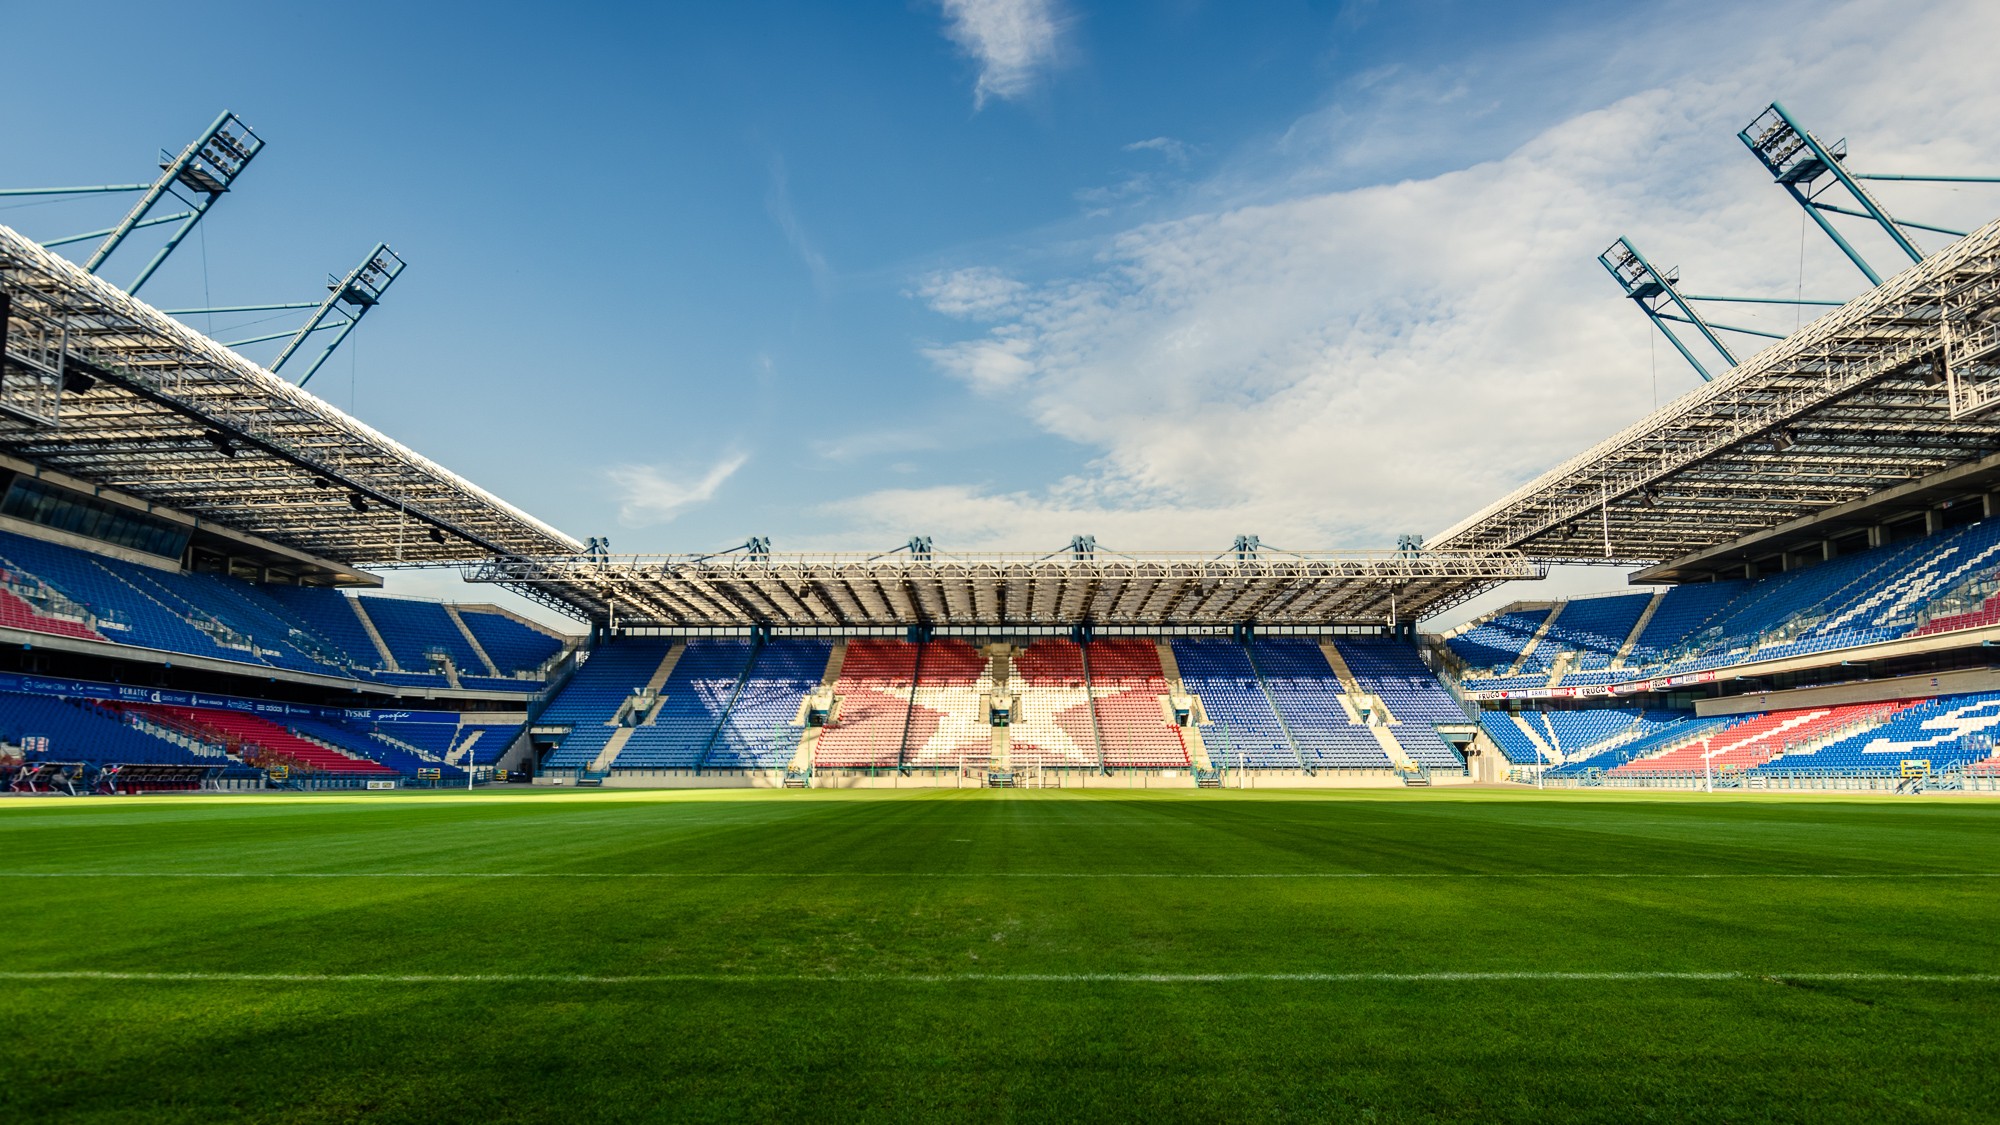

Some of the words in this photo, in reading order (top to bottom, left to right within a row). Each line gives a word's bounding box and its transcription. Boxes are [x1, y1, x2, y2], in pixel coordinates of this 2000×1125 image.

[1478, 691, 1500, 700] FRUGO
[1582, 686, 1606, 696] FRUGO
[265, 704, 283, 713] adidas
[344, 709, 372, 718] TYSKIE
